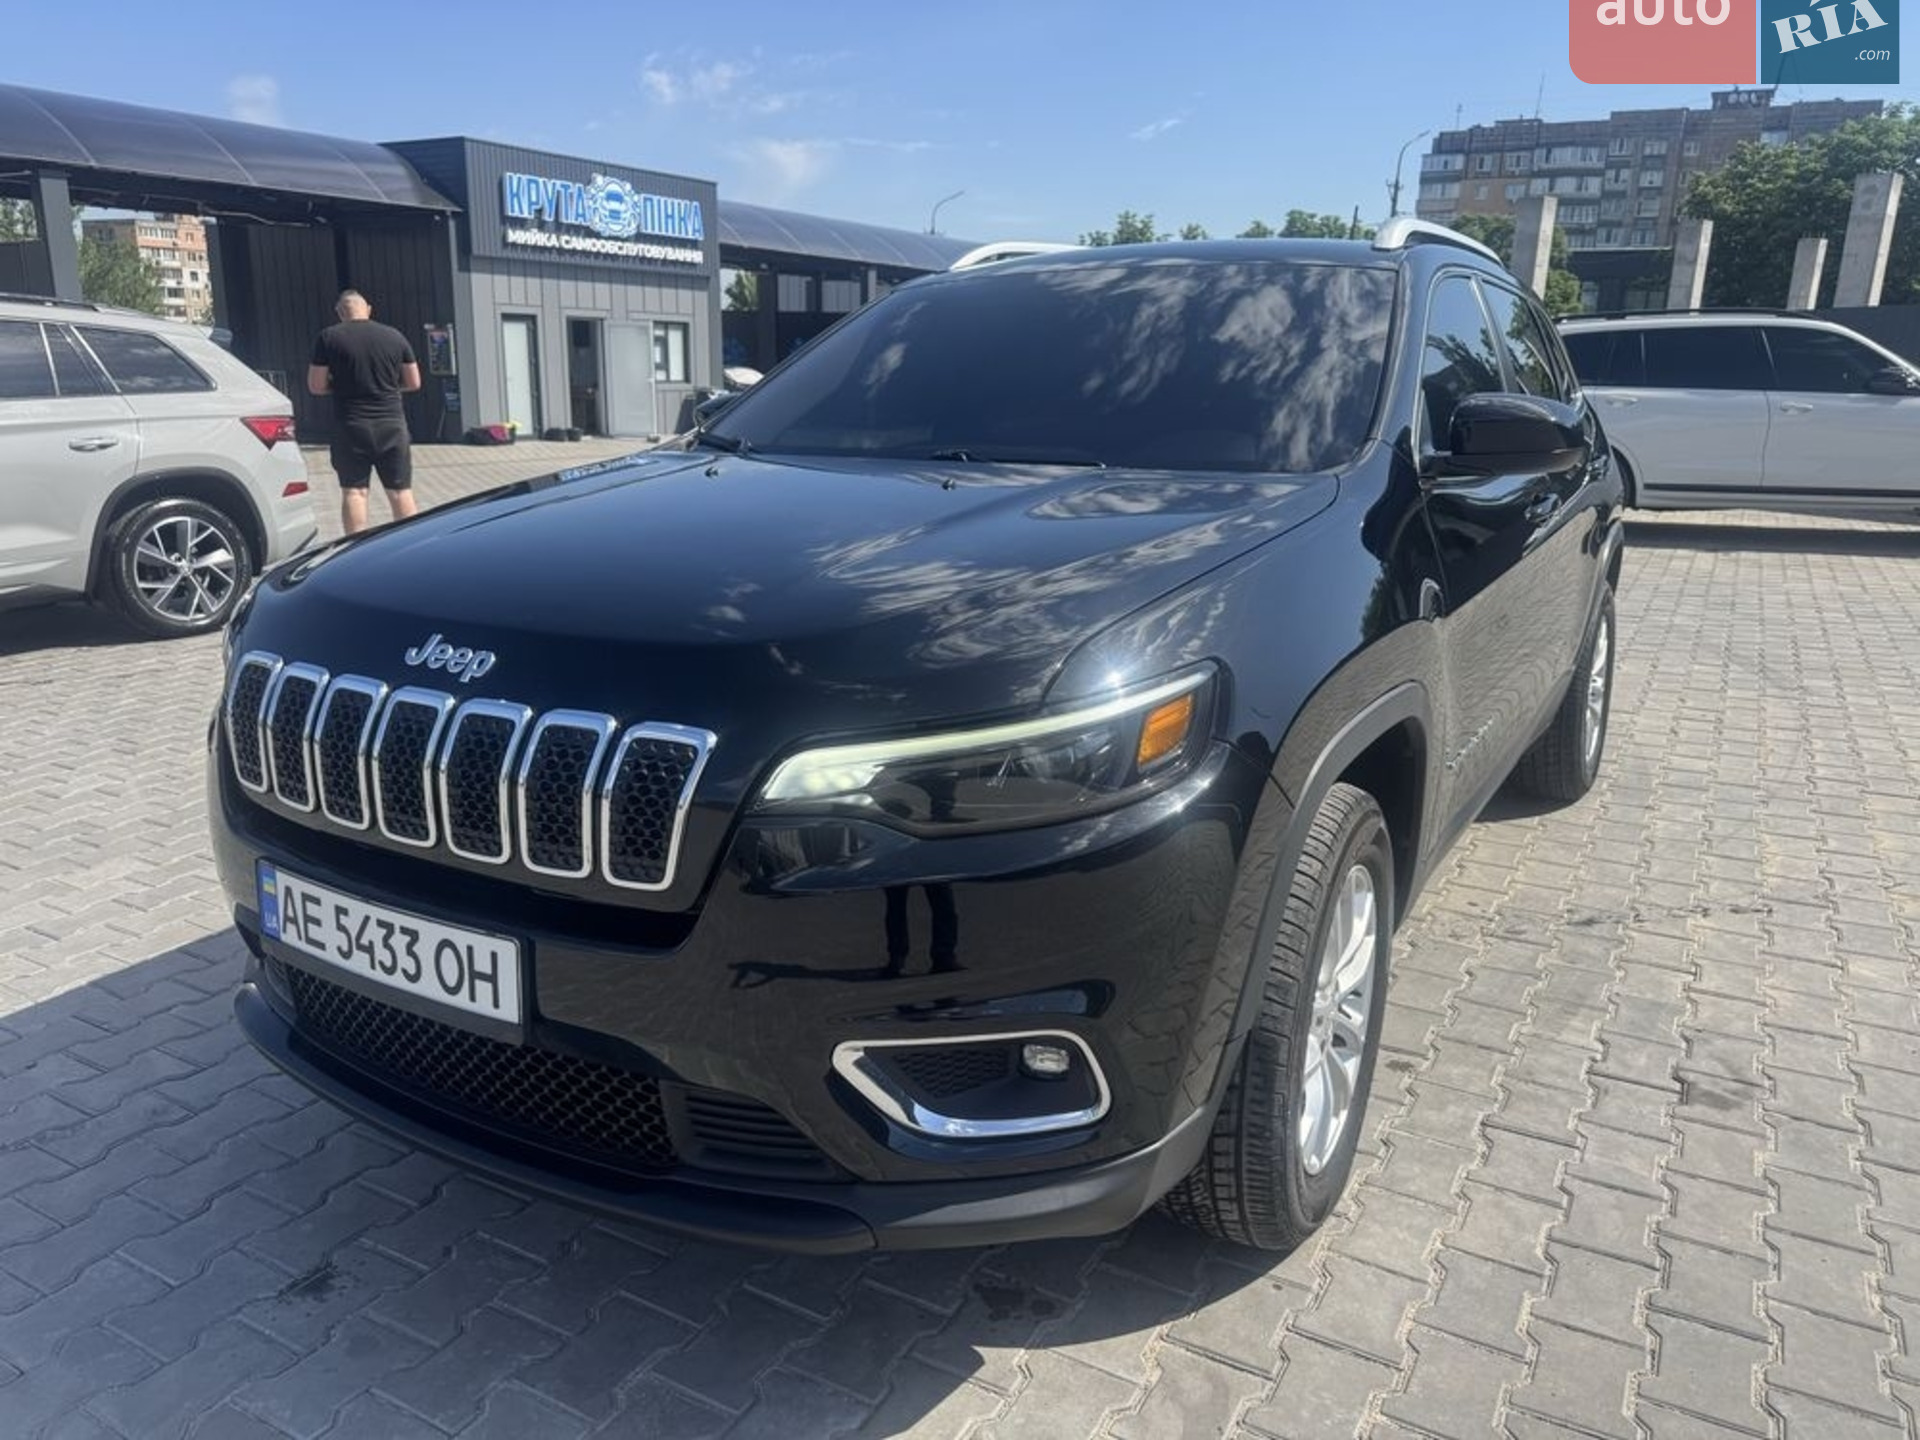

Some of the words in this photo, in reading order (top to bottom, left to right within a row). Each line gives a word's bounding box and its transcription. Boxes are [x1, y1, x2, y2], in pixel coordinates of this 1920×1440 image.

[506, 172, 589, 226] КРУТА
[640, 193, 704, 240] ПІНКА
[507, 228, 560, 249] МИЙКА
[405, 633, 496, 683] Jeep
[282, 885, 326, 951] AE
[334, 904, 422, 984] 5433
[434, 938, 500, 1009] OH
